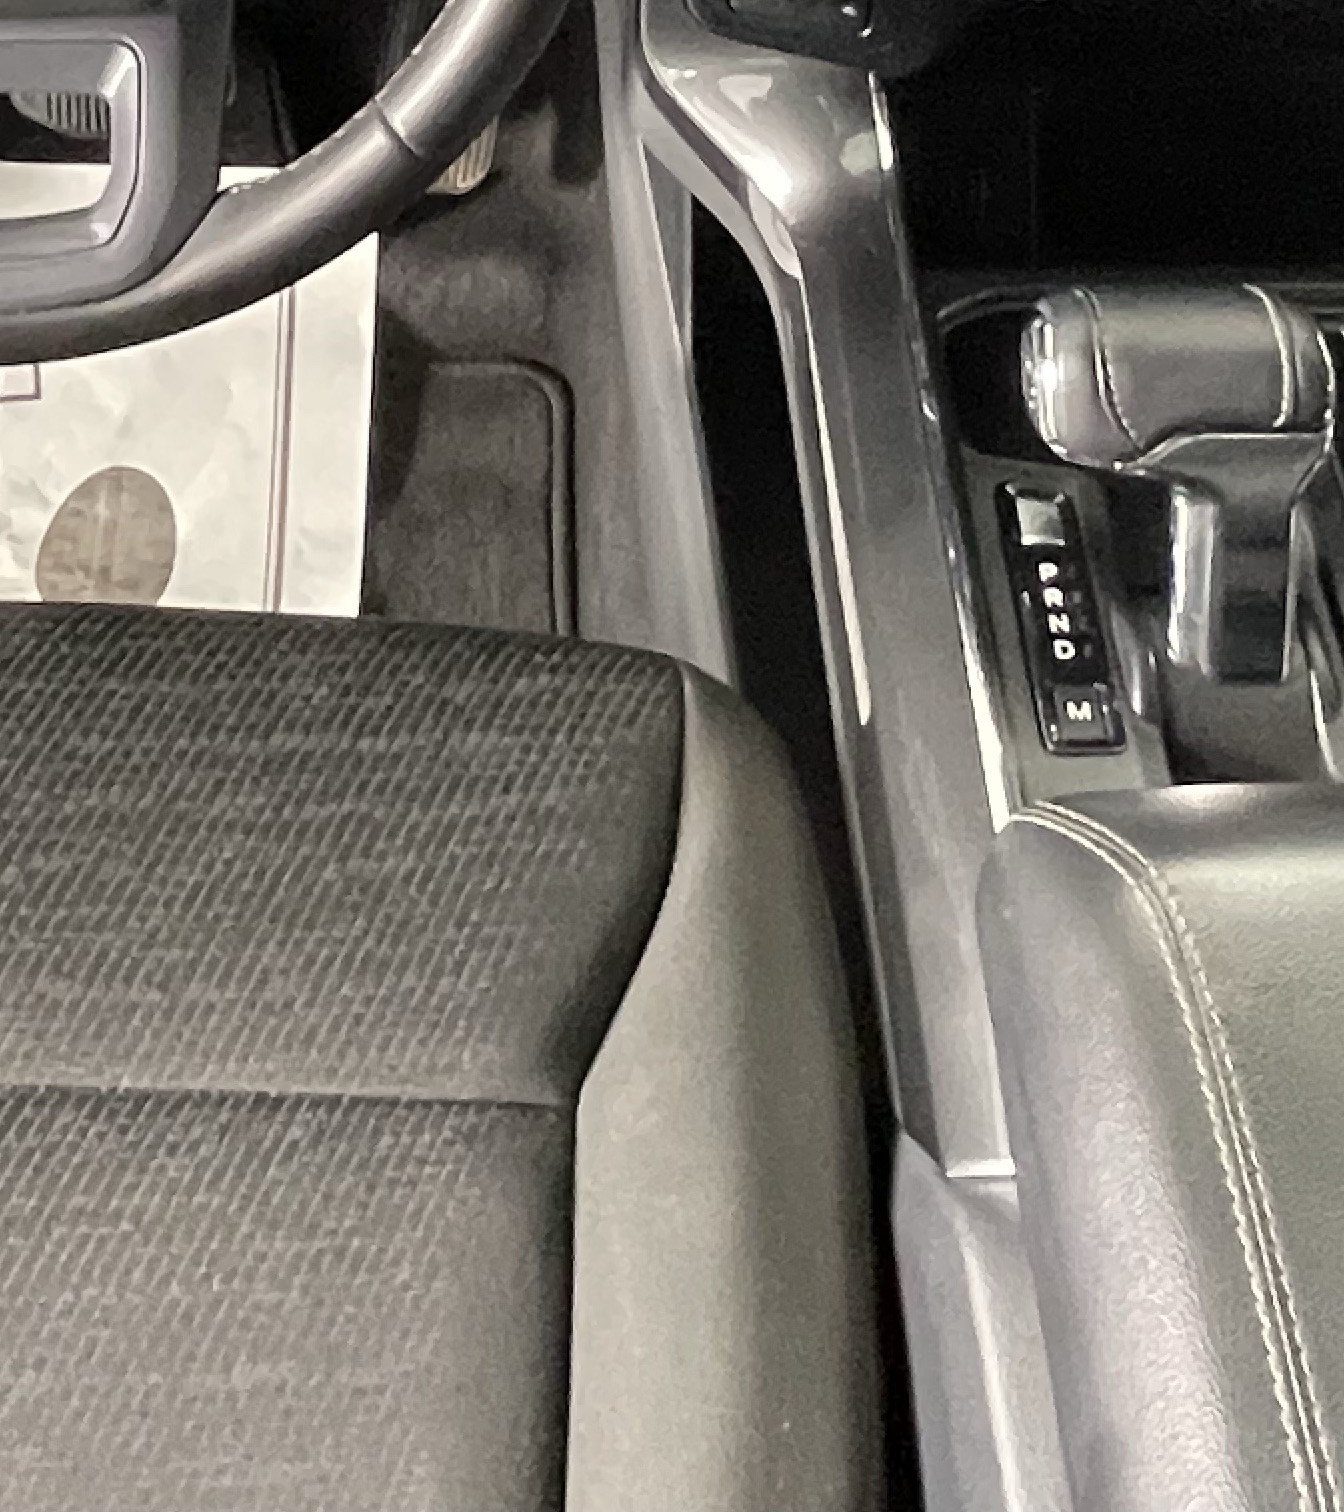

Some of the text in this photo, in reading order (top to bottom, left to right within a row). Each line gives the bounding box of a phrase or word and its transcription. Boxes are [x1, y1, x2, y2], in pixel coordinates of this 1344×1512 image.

[1039, 563, 1058, 581] P
[1043, 587, 1063, 607] R
[1047, 612, 1070, 634] N
[1053, 638, 1076, 660] D
[1066, 700, 1092, 722] M
